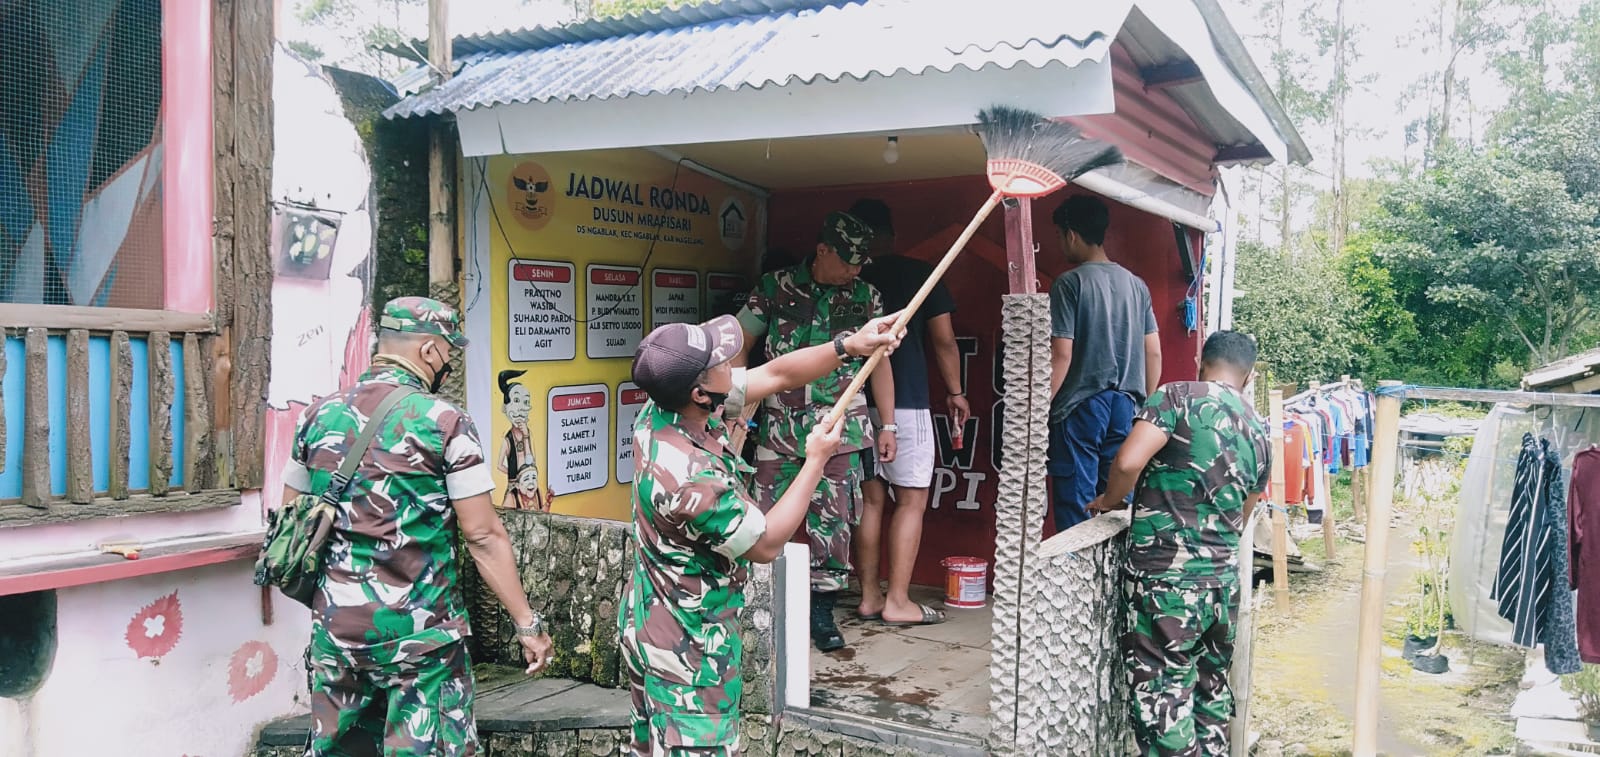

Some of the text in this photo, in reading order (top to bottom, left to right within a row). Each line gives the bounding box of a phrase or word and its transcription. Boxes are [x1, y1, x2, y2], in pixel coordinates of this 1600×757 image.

[566, 173, 711, 215] JADWAL RONDA
[593, 207, 691, 232] DUSUN MRAPISARI
[577, 225, 585, 233] DS
[621, 230, 632, 238] KEC
[532, 269, 554, 278] SENIN
[604, 273, 626, 281] SELASA
[524, 288, 562, 299] PRAYITNO
[514, 313, 572, 324] SUHARJO PARDI
[515, 326, 571, 336] ELI DARMANTO
[534, 339, 552, 348] AGIT
[606, 338, 626, 347] SUJADI
[568, 443, 597, 455] SARIMIN
[566, 457, 592, 469] JUMADI
[567, 472, 591, 483] TUBARI
